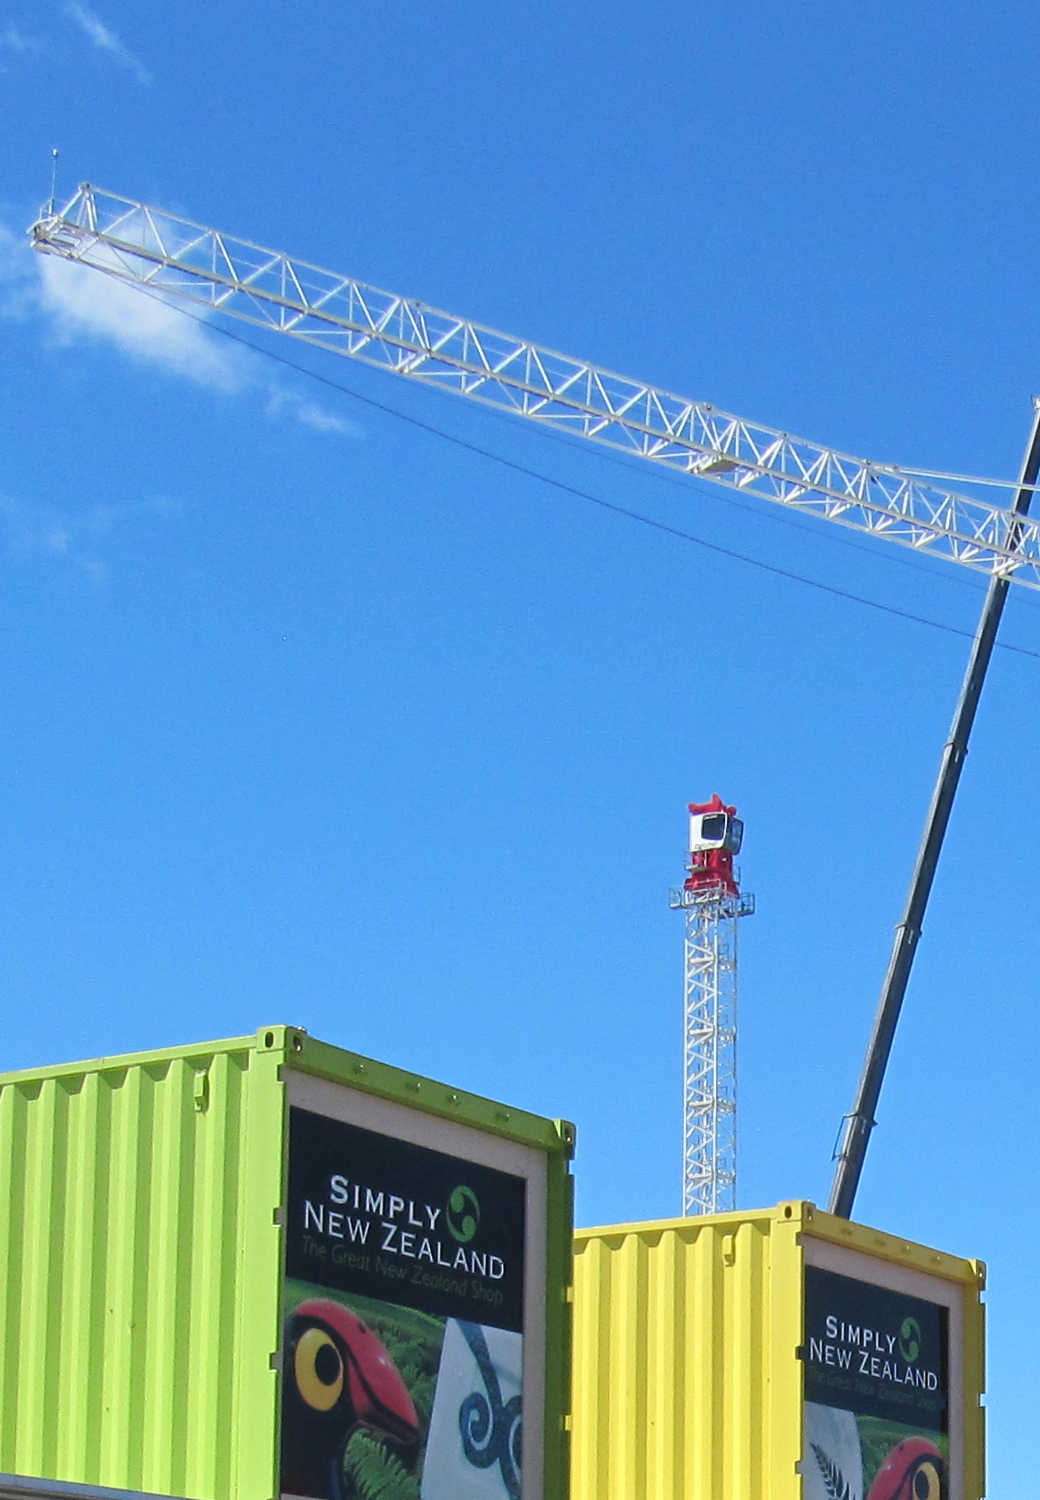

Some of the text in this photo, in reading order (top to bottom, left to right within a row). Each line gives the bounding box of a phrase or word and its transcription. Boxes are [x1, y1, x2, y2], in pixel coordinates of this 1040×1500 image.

[330, 1174, 441, 1231] SIMPLY
[304, 1200, 505, 1280] NEW ZEALAND
[302, 1235, 503, 1305] The Great New Zealand Shop
[826, 1315, 896, 1354] SIMPLY
[810, 1337, 938, 1391] NEW ZEALAND
